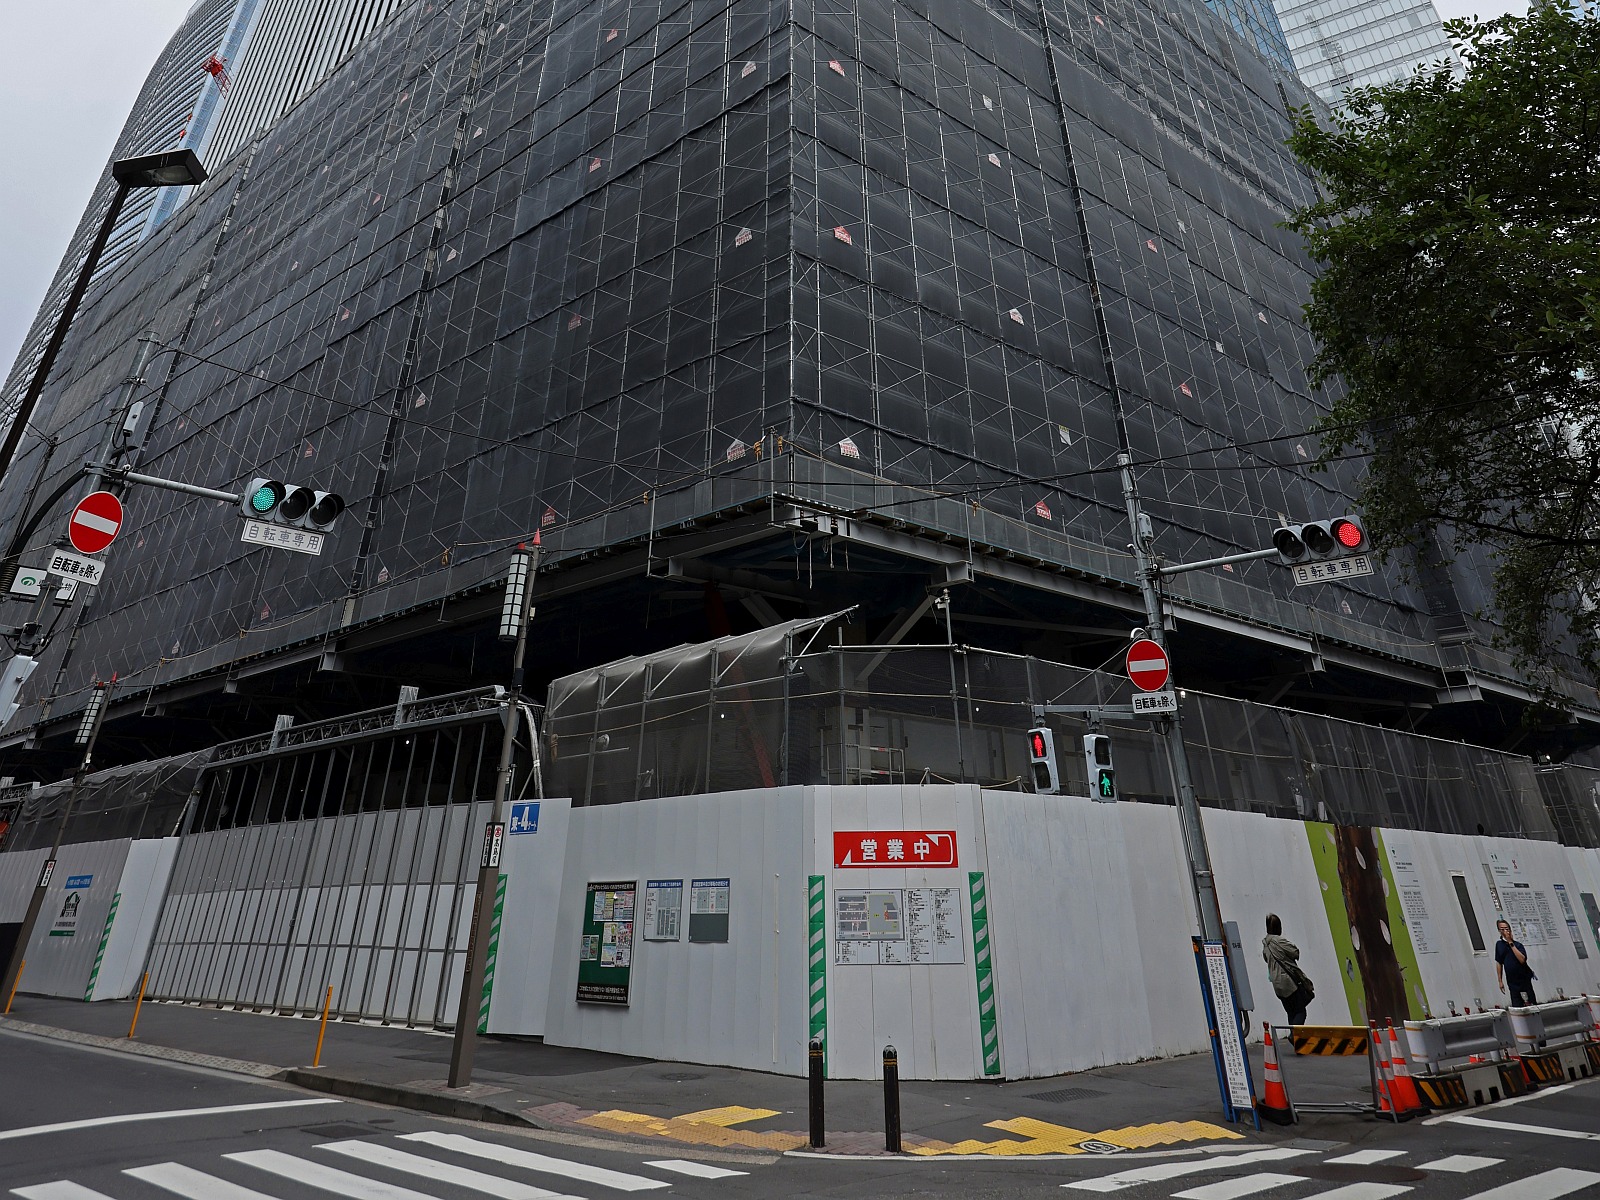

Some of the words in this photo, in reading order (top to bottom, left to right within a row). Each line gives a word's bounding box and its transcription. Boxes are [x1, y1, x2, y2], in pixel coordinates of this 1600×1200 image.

[249, 524, 320, 550] 自転車専用
[52, 556, 100, 580] 自転車を除く
[1298, 558, 1368, 580] 自転車専用
[1135, 696, 1175, 710] 自転車を除く
[860, 839, 930, 861] 営業中
